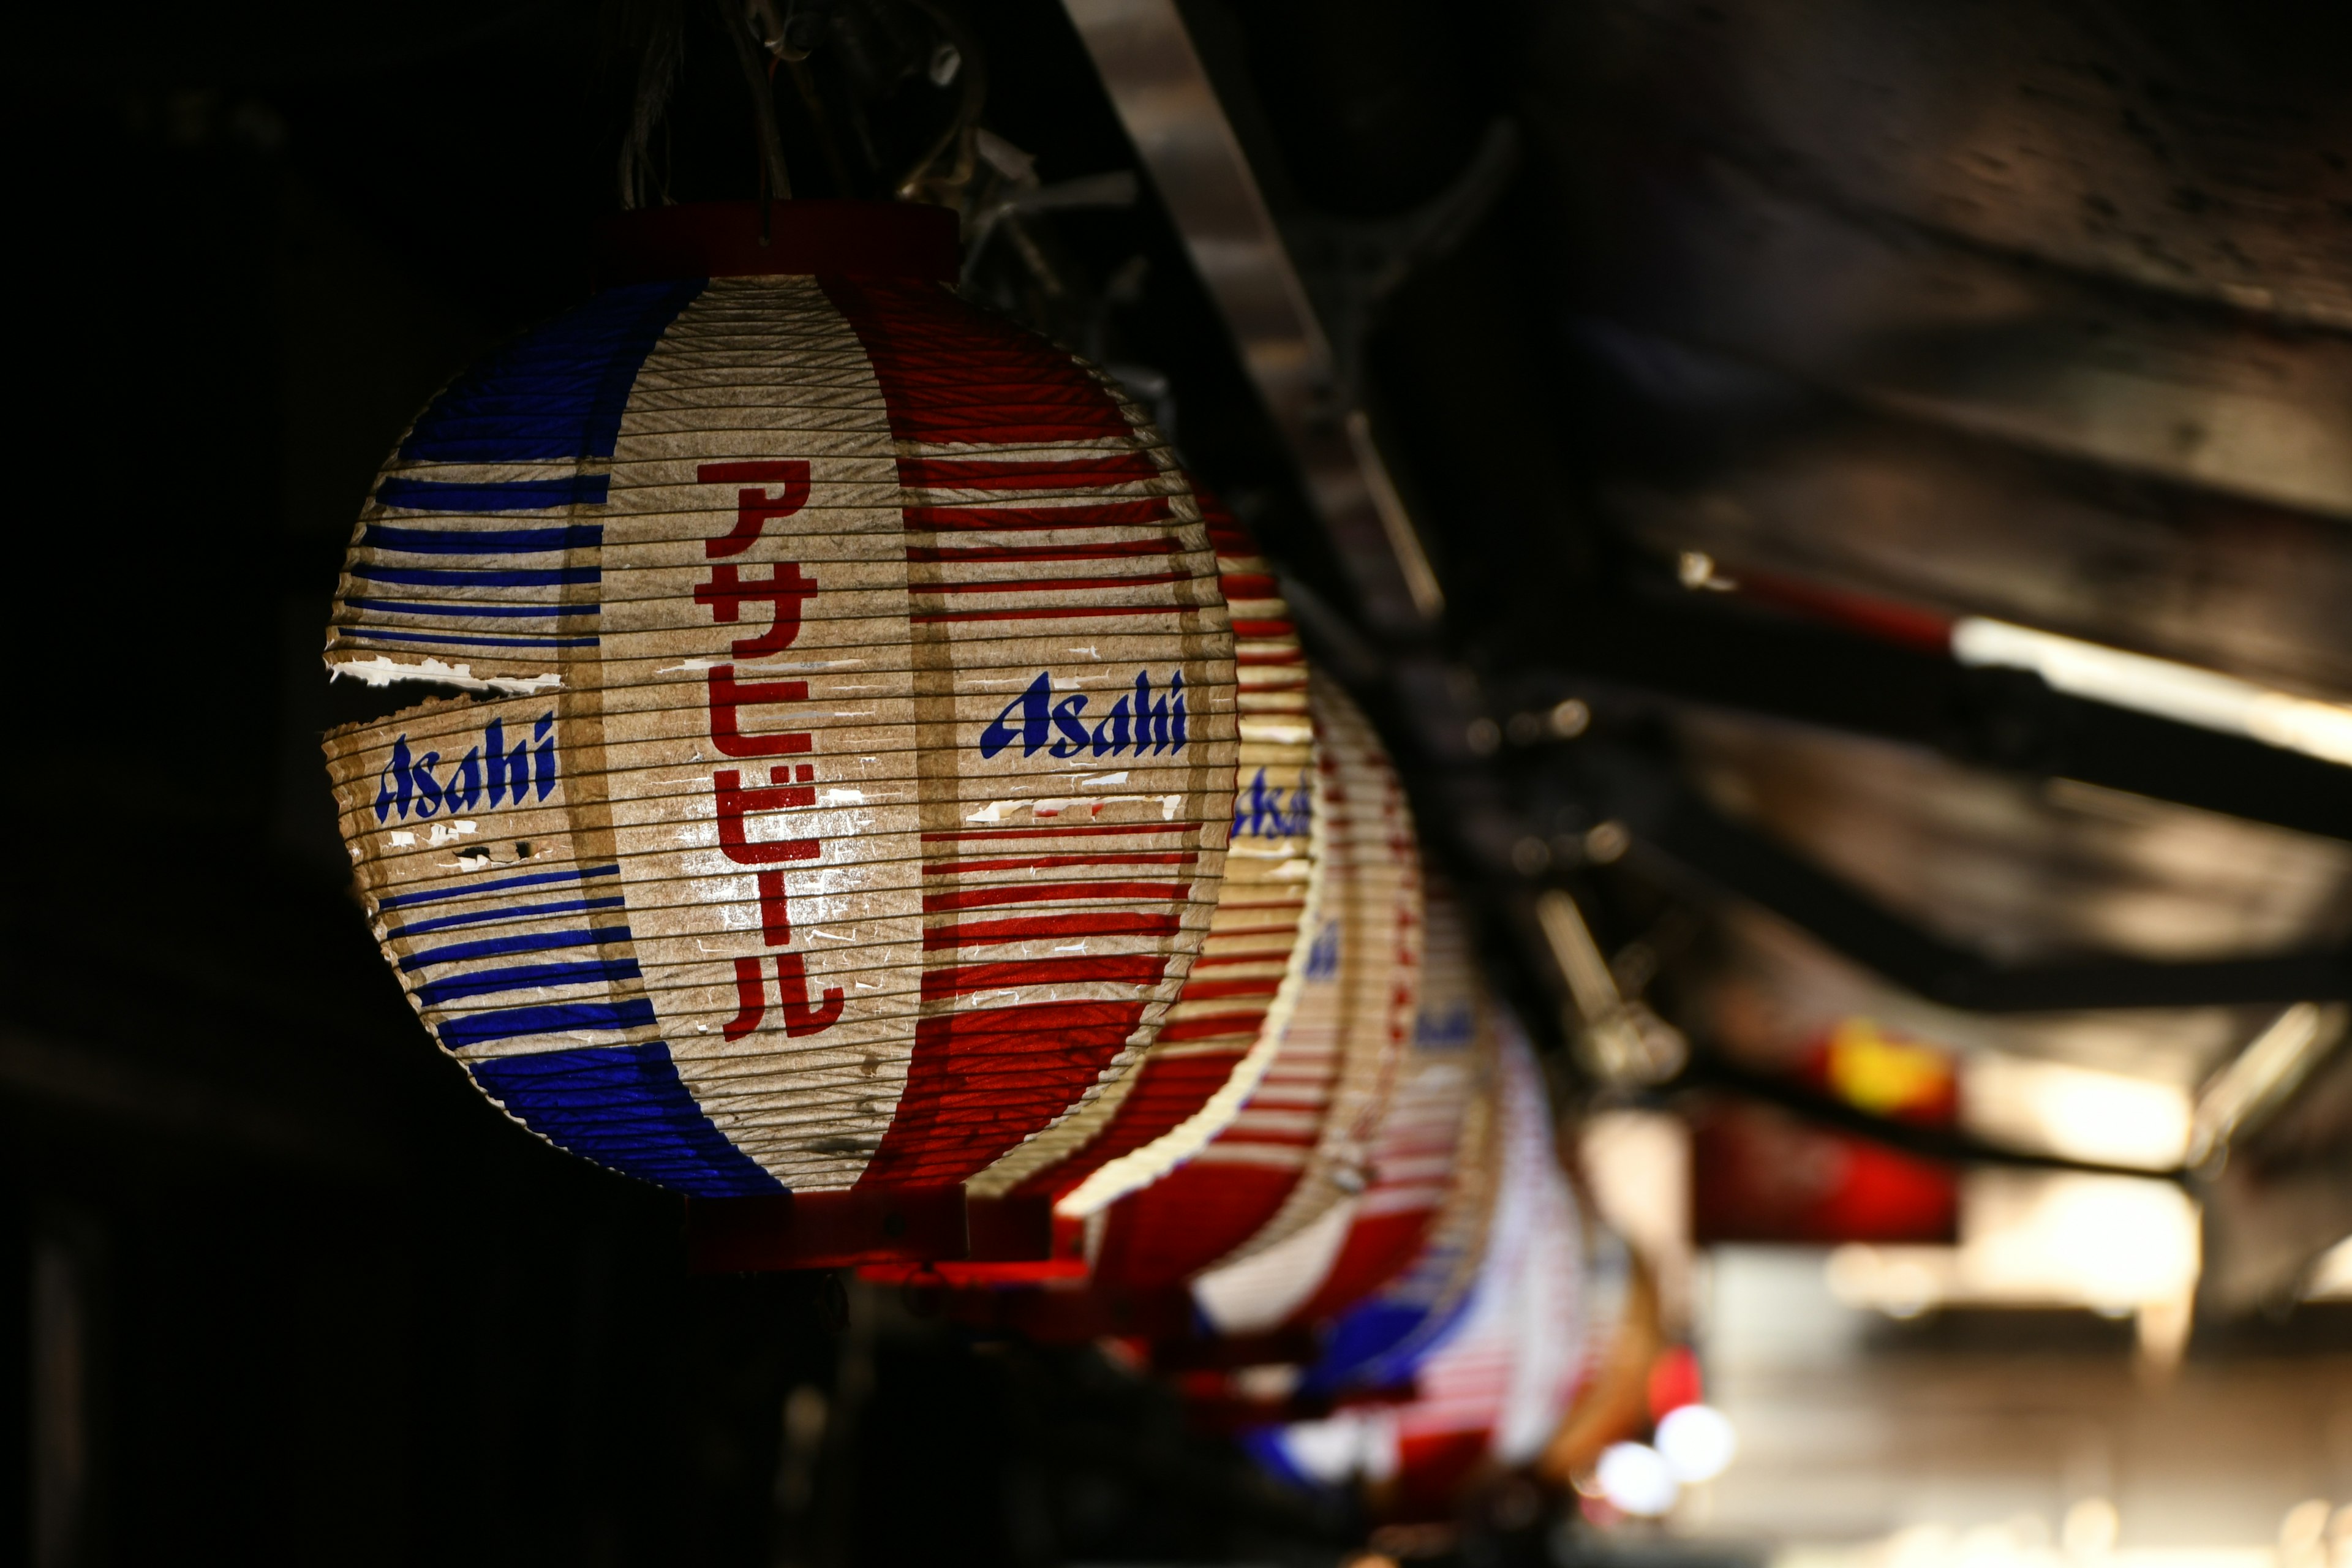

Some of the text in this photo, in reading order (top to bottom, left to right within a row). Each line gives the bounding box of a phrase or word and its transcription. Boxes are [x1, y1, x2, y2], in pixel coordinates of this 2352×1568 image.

[374, 710, 556, 824] Asahi
[694, 460, 844, 1042] アサヒビール
[979, 669, 1188, 759] Asahi
